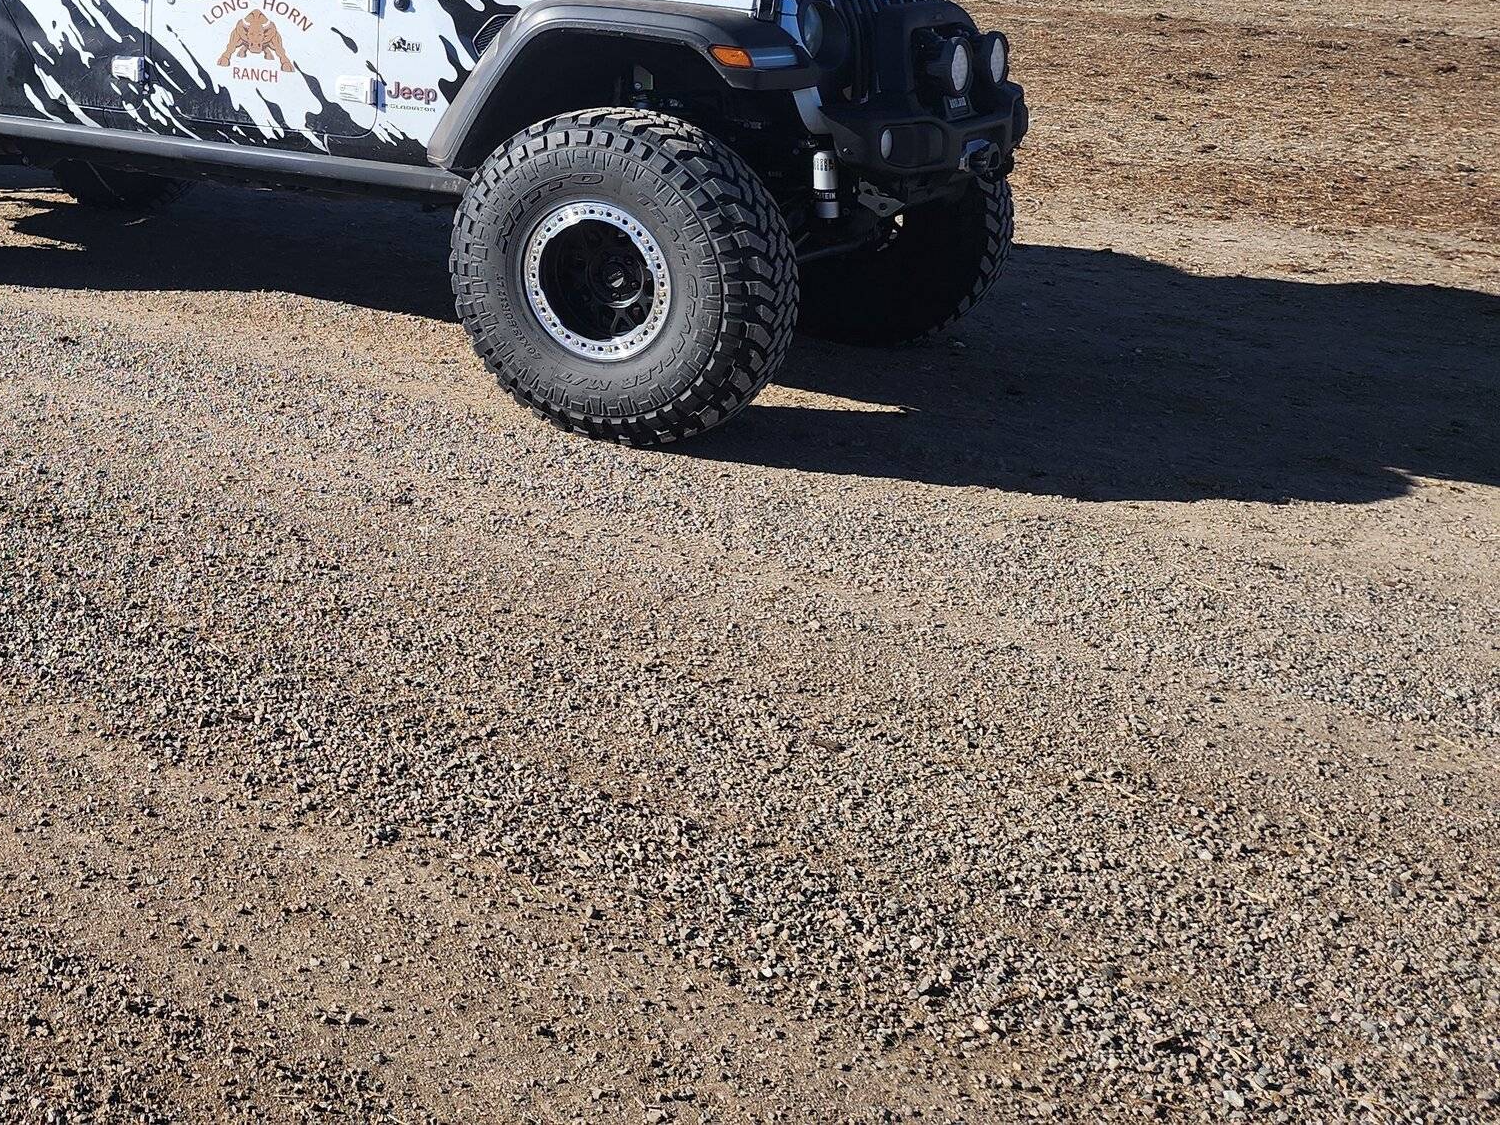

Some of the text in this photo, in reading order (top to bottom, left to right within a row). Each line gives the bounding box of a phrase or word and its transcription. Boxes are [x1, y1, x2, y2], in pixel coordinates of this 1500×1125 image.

[406, 42, 421, 52] AEV
[232, 66, 279, 83] RANCH
[386, 81, 438, 105] Jeep
[493, 172, 605, 254] NITTO
[636, 191, 691, 266] TRAIL
